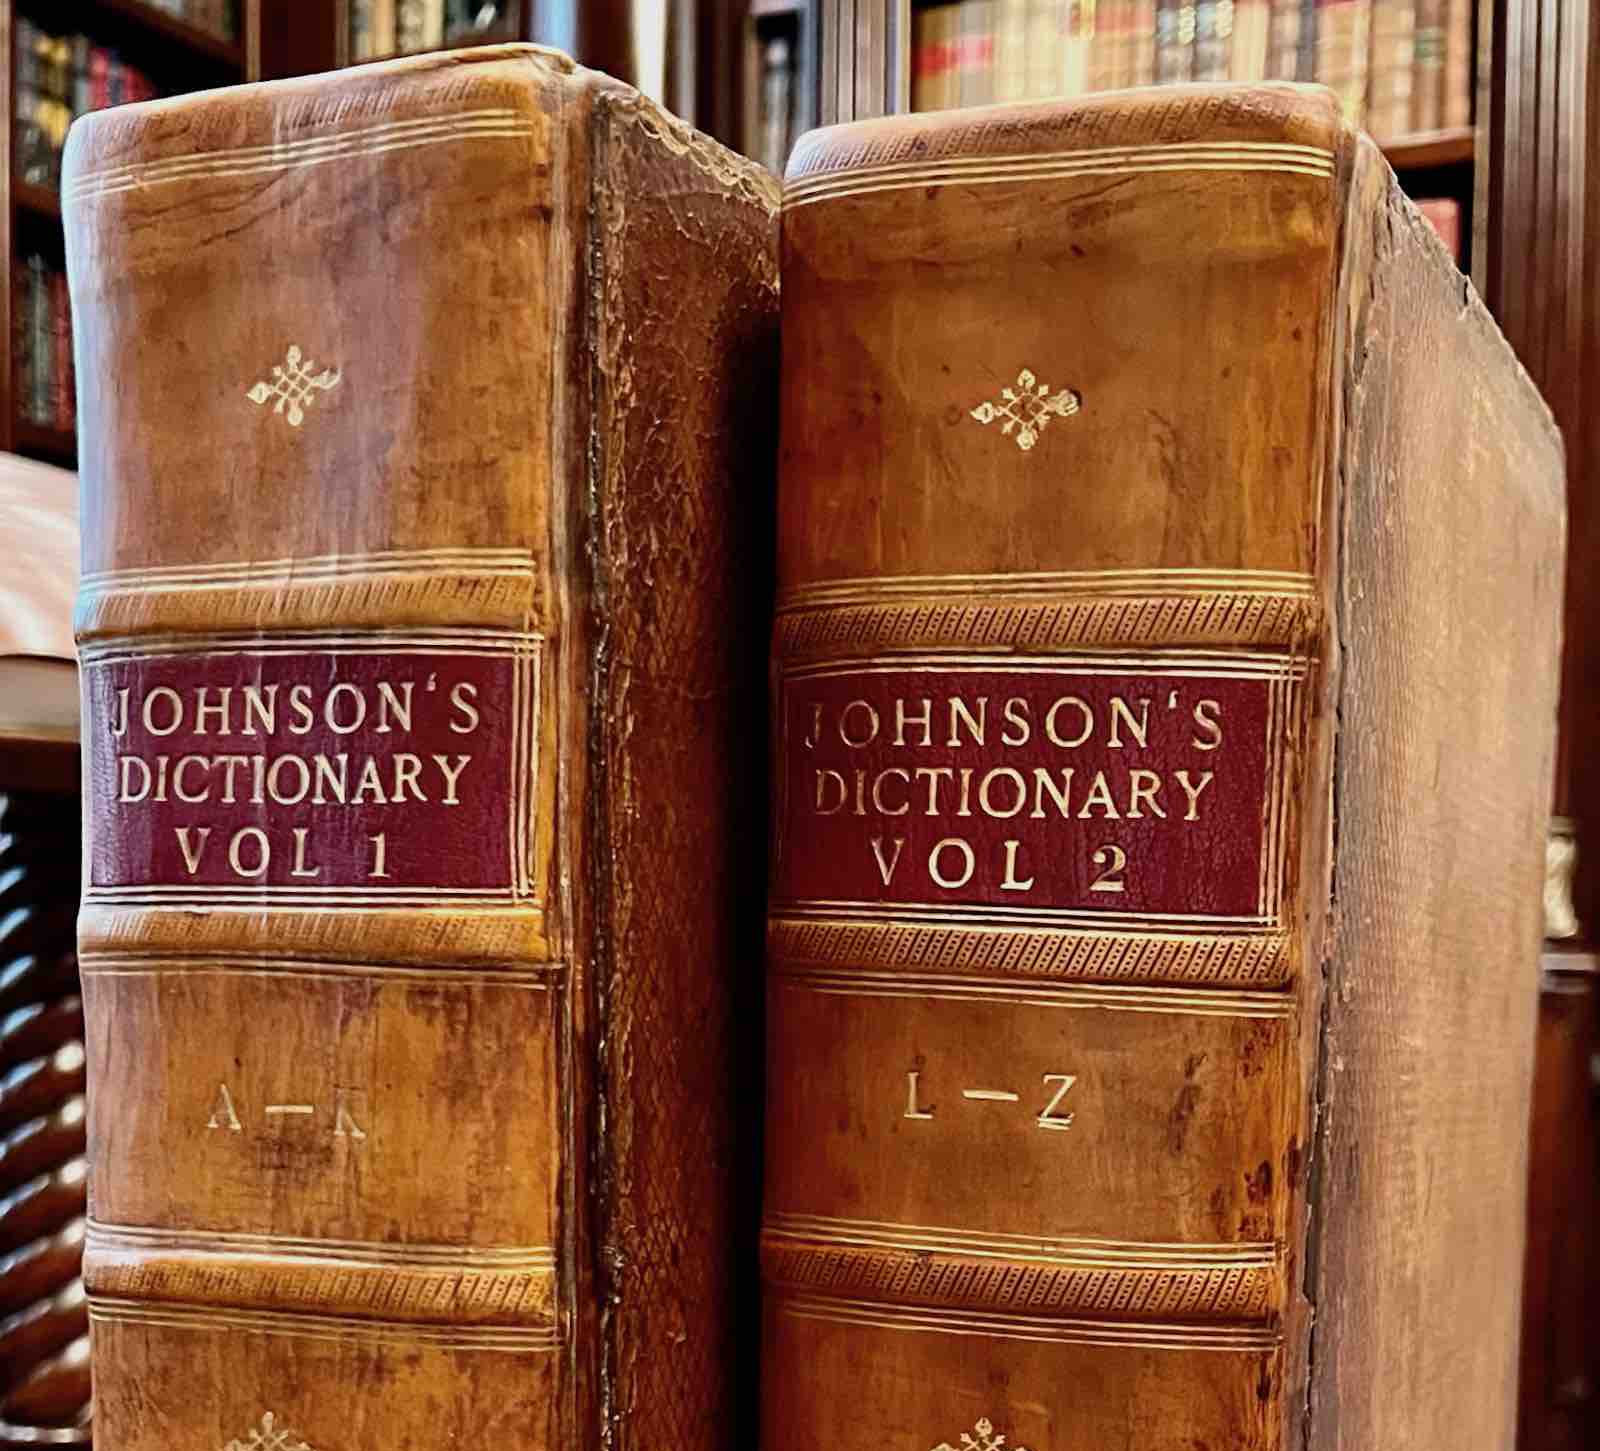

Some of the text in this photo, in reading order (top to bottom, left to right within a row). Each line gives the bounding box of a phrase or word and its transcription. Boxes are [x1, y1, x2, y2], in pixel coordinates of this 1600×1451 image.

[111, 672, 480, 737] JOHNSON'S
[119, 752, 472, 805] DICTIONARY
[815, 767, 1214, 822] DICTIONARY
[174, 826, 391, 879] VOL 1
[871, 837, 1127, 892] VOL 2
[903, 1071, 934, 1120] L
[1037, 1074, 1077, 1131] Z
